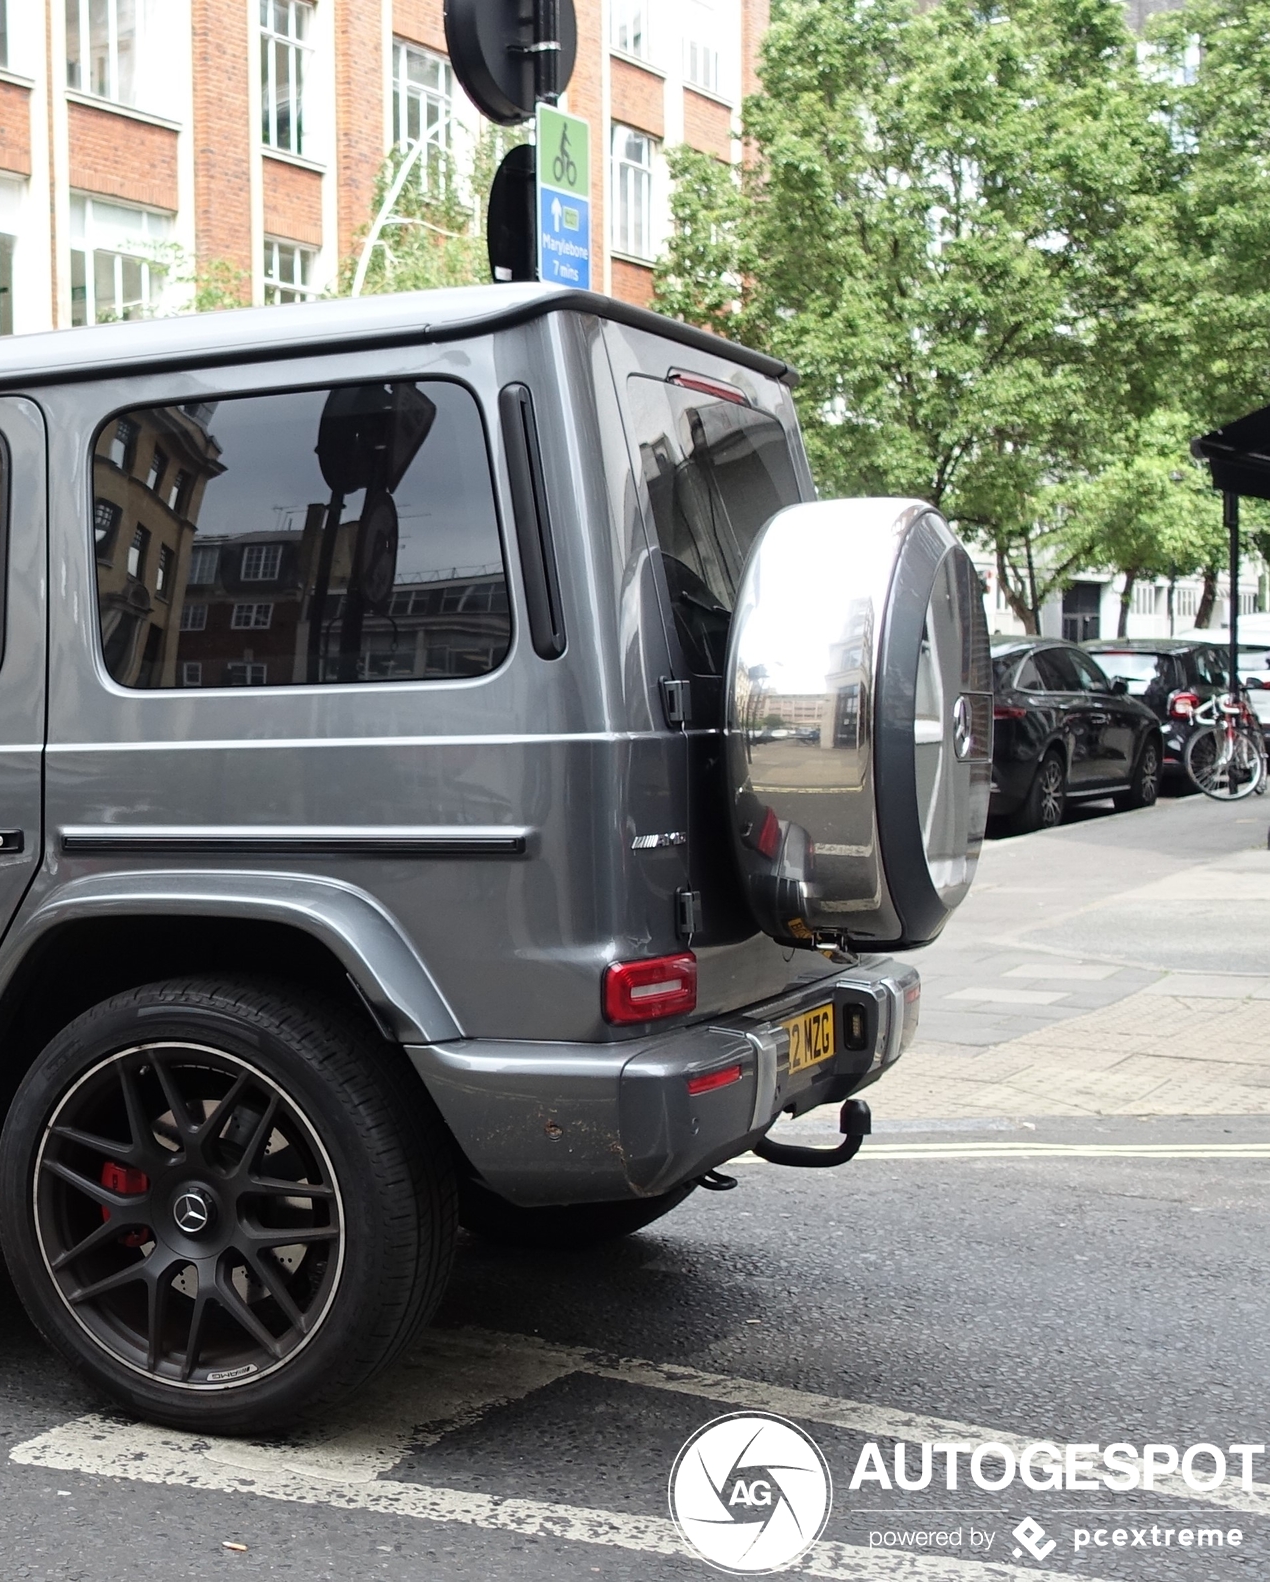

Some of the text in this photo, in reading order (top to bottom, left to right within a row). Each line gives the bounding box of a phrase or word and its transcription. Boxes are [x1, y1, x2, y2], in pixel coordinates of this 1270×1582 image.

[542, 232, 589, 260] Marylebone
[553, 259, 579, 282] 7 mins
[803, 1011, 830, 1063] MZG
